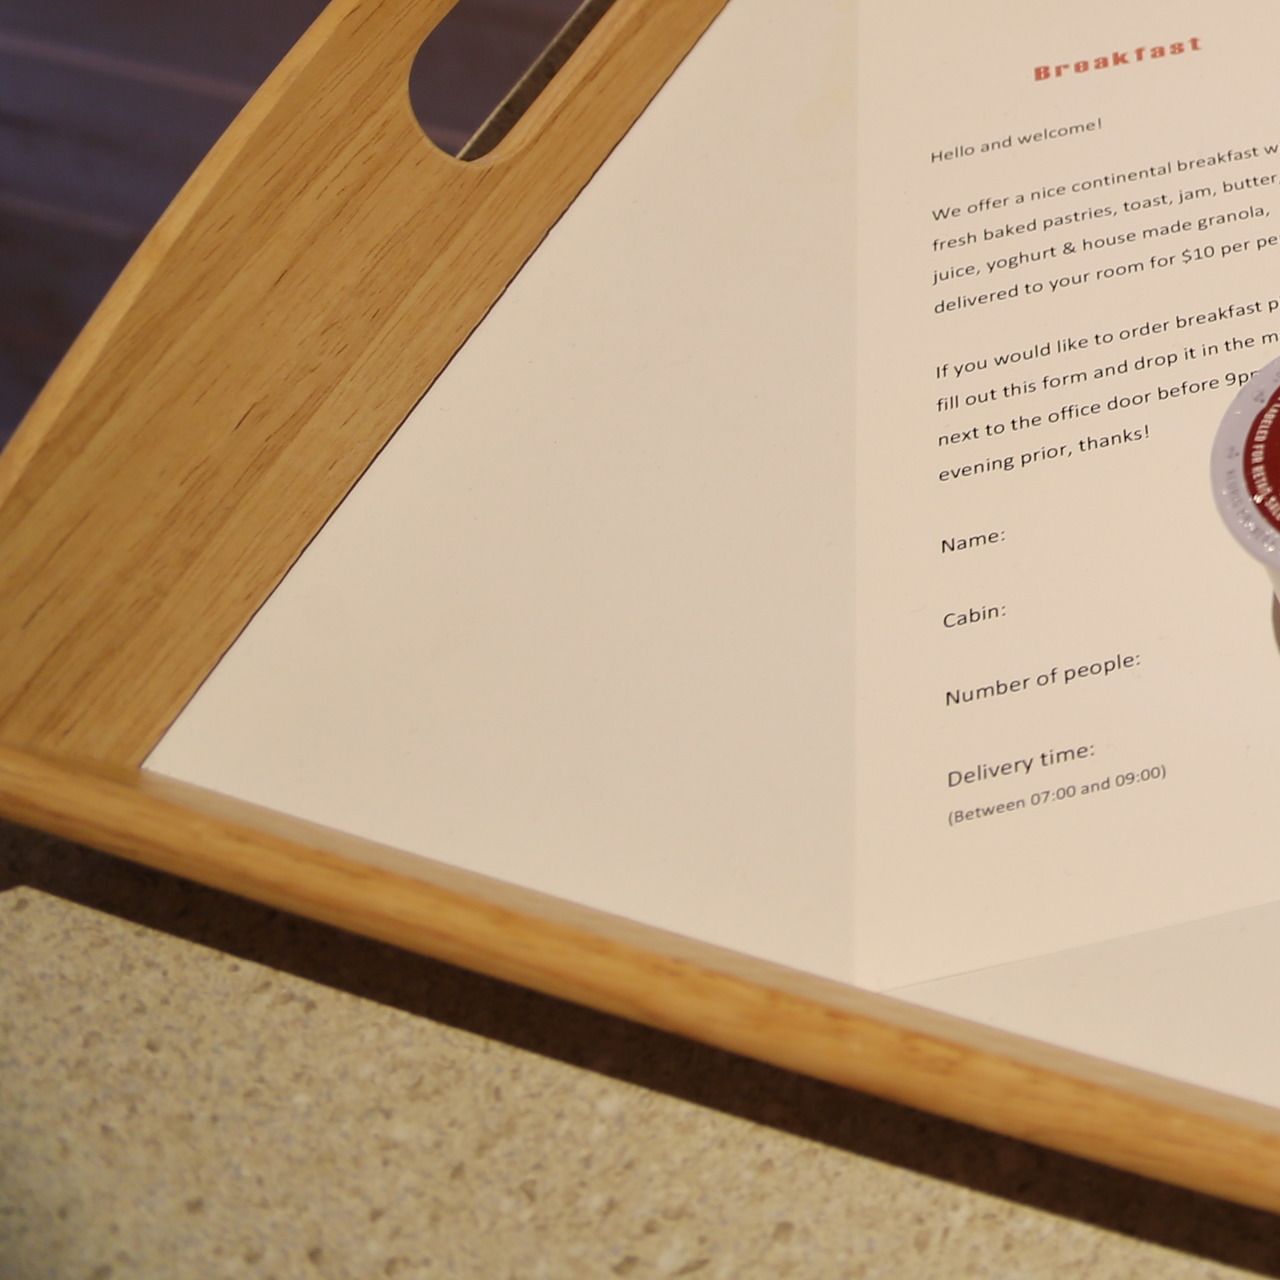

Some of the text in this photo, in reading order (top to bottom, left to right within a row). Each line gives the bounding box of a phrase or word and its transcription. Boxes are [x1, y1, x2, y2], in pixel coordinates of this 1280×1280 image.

[1033, 36, 1203, 82] Breakfast
[930, 116, 1102, 164] Hello and welcome!
[931, 206, 962, 222] We
[966, 196, 1010, 215] offer
[1015, 194, 1025, 205] a
[1030, 185, 1067, 202] nice
[1071, 160, 1172, 193] continental
[1176, 146, 1260, 172] breakfast
[931, 231, 977, 253] fresh
[983, 217, 1037, 242] baked
[1042, 206, 1118, 232] pastries,
[1122, 193, 1174, 213] toast,
[1177, 187, 1217, 206] jam,
[932, 204, 1271, 287] juice, yoghurt & house made granola,
[933, 283, 1019, 315] delivered
[1023, 282, 1044, 295] to
[1048, 271, 1091, 293] your
[1096, 261, 1145, 281] room
[1149, 254, 1177, 270] for
[1181, 245, 1215, 265] $10
[1220, 240, 1251, 259] per
[936, 363, 950, 380] If
[952, 358, 988, 379] you
[993, 341, 1051, 367] would
[1056, 337, 1089, 354] like
[1093, 332, 1114, 346] to
[1118, 320, 1170, 341] order
[1175, 300, 1264, 329] breakfast
[935, 394, 960, 413] fill
[964, 388, 998, 407] out
[1001, 380, 1037, 399] this
[1041, 371, 1088, 391] form
[1093, 359, 1129, 380] and
[1133, 352, 1179, 371] drop
[1183, 346, 1197, 361] it
[1201, 343, 1219, 358] in
[1223, 336, 1256, 353] the
[938, 426, 980, 448] next
[984, 423, 1006, 437] to
[1009, 415, 1043, 432] the
[1047, 403, 1102, 424] office
[1106, 391, 1152, 412] door
[1157, 378, 1220, 401] before
[1254, 402, 1280, 443] LABELED
[938, 423, 1150, 482] evening prior, thanks!
[1251, 442, 1265, 461] FOR
[941, 530, 1006, 556] Name:
[942, 604, 1008, 630] Cabin:
[945, 652, 1142, 708] Number of people:
[947, 744, 1096, 789] Delivery time:
[947, 763, 1167, 827] (Between 07:00 and 09:00)
